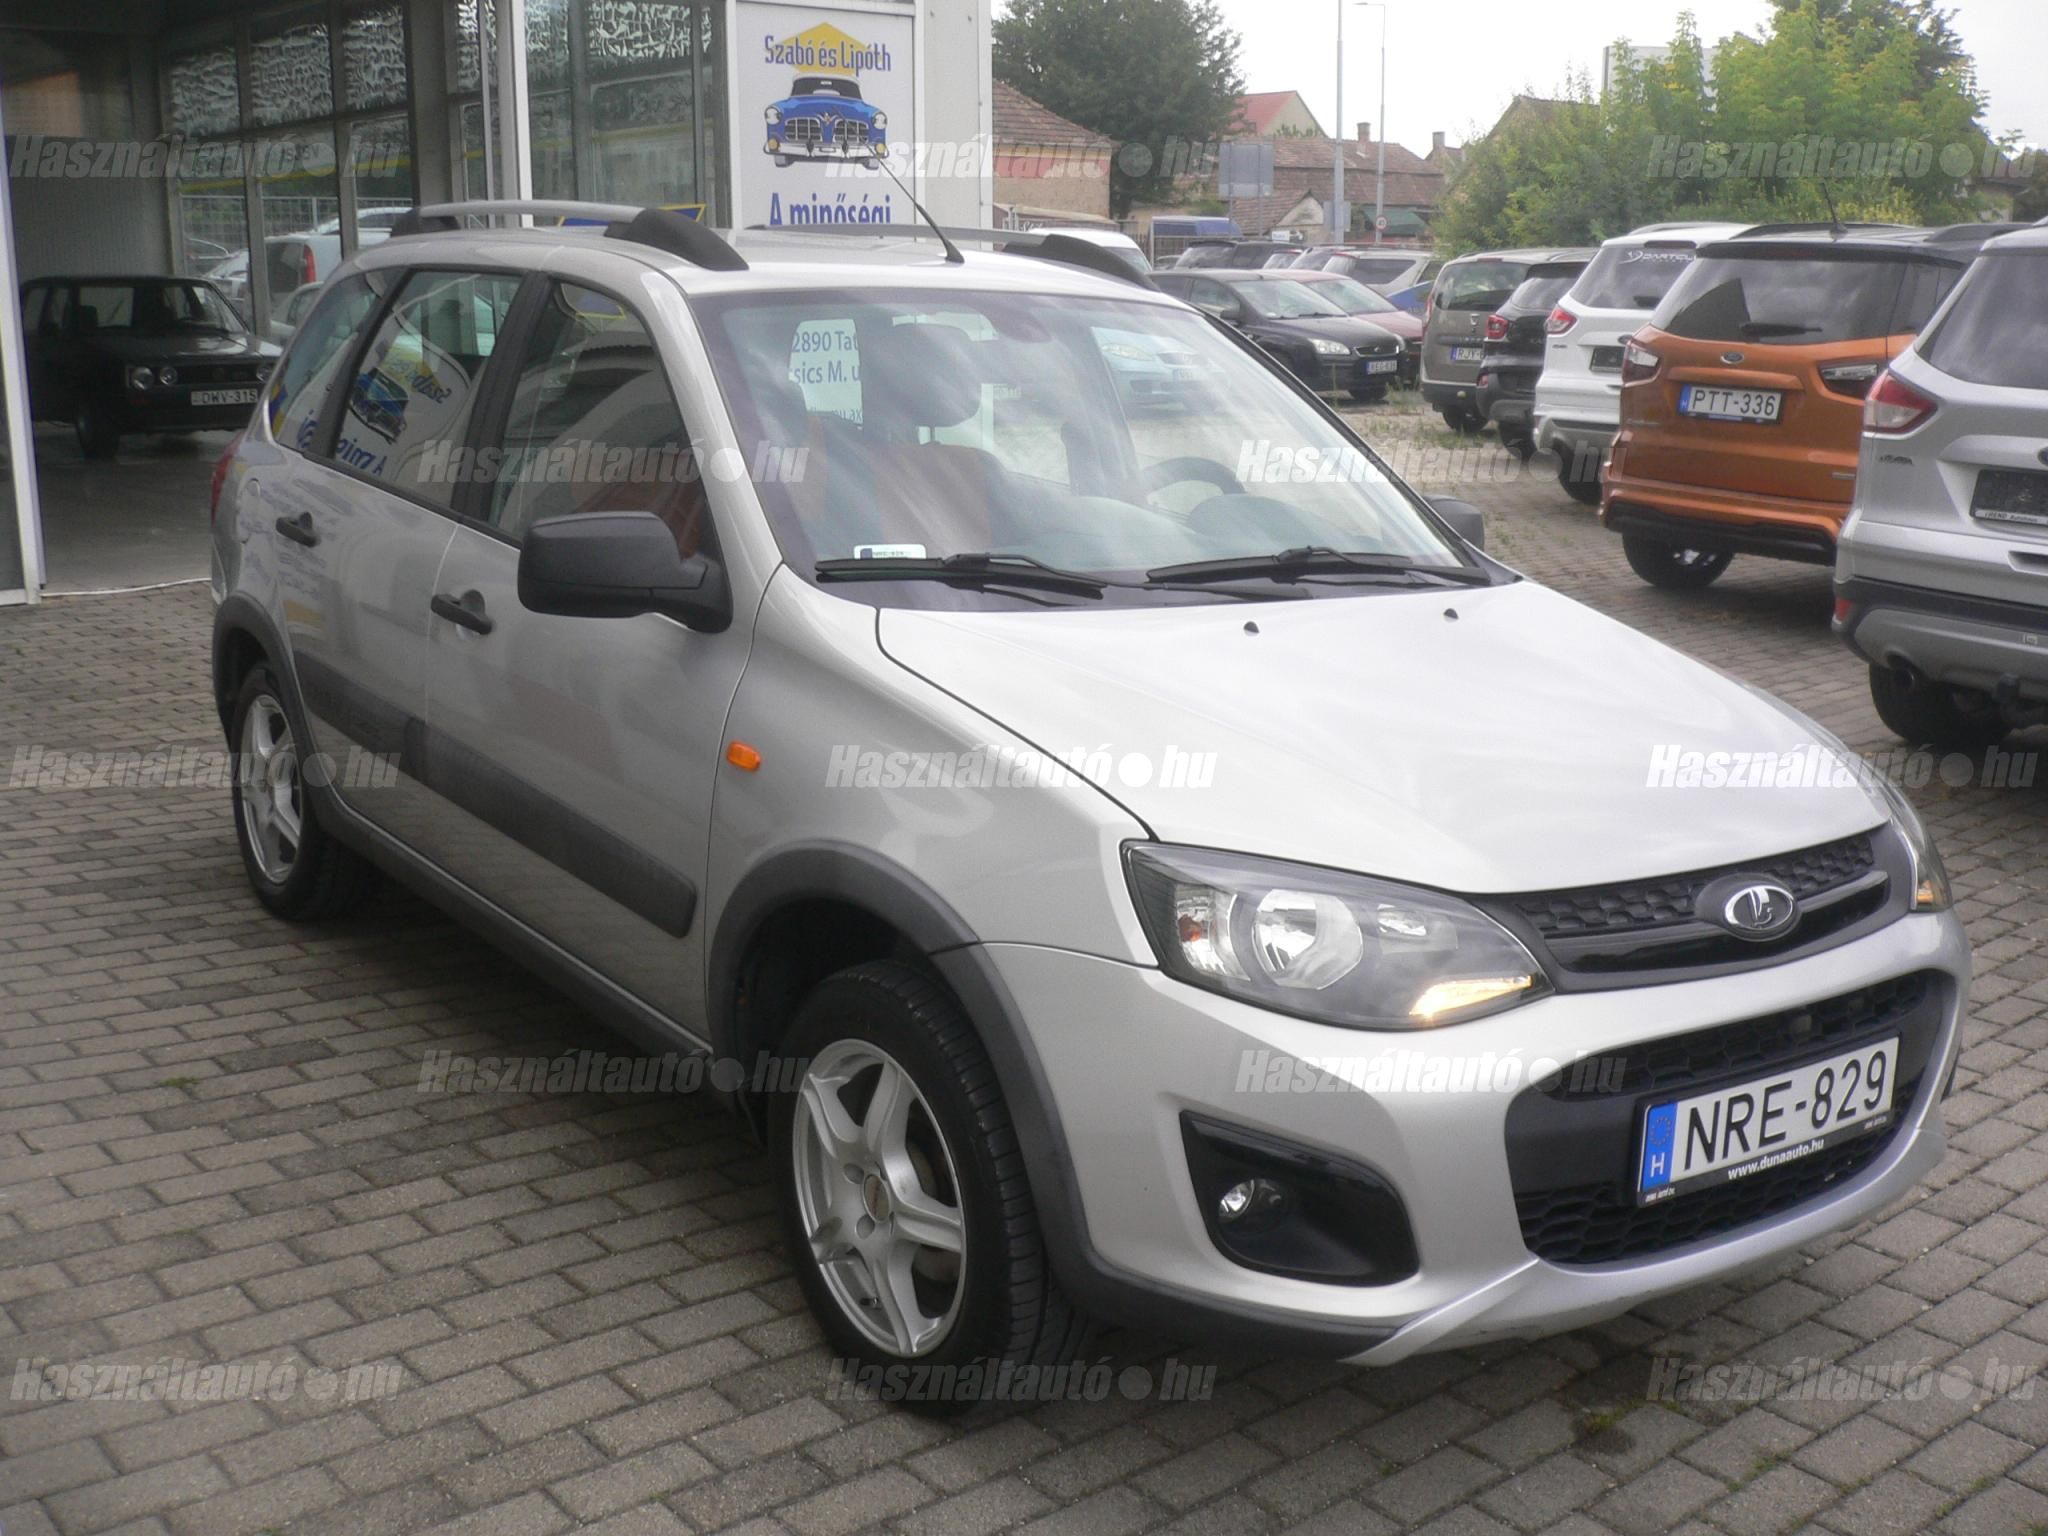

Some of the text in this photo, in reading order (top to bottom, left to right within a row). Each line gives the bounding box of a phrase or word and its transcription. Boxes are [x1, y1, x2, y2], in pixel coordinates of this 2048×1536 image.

[765, 35, 891, 77] Szabó és Lipóth
[770, 192, 782, 225] A
[792, 331, 832, 353] 2890
[1692, 389, 1776, 416] PTT-336
[1683, 1050, 1889, 1171] NRE-829
[1650, 1151, 1665, 1178] H
[1727, 1137, 1825, 1180] www.dunaauto.hu
